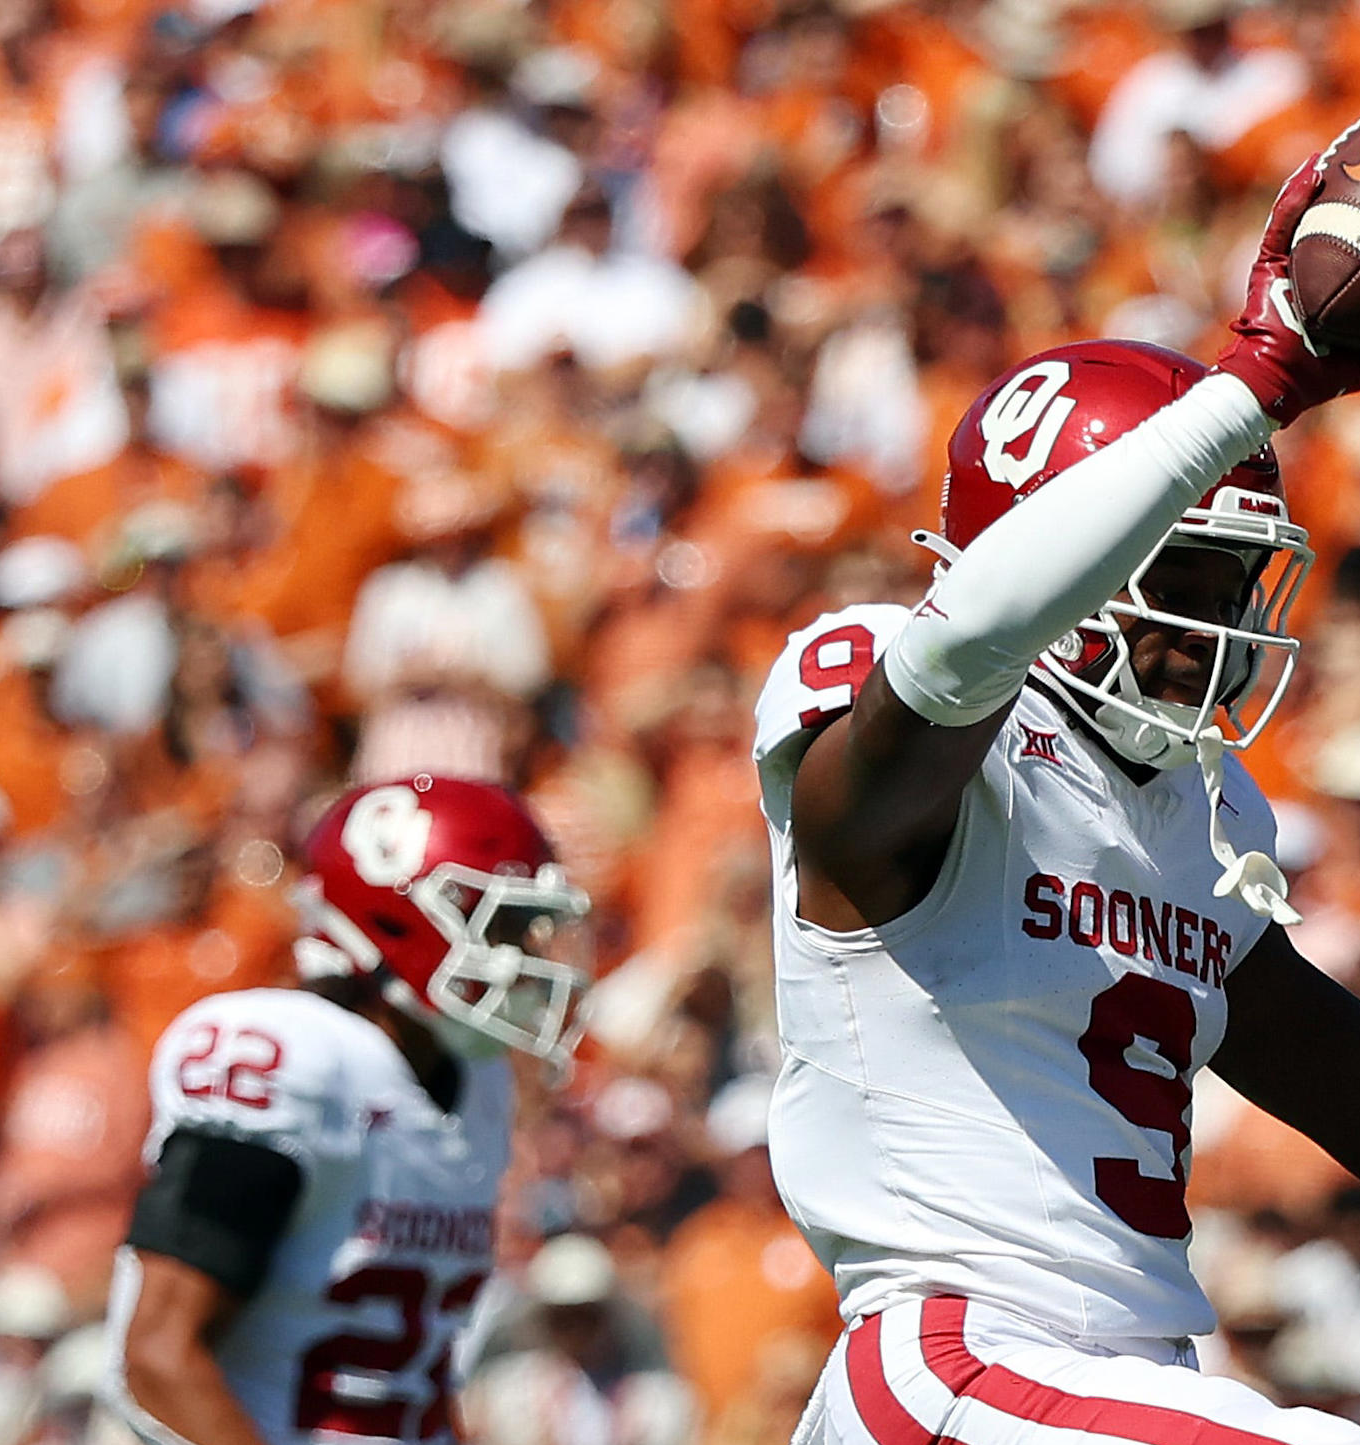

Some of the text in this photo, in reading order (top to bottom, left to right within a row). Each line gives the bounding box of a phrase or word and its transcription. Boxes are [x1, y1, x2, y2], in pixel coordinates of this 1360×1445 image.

[980, 360, 1077, 490] OU
[799, 624, 875, 729] 9
[1022, 872, 1231, 989] SOONERS
[179, 1024, 284, 1108] 22
[1079, 972, 1199, 1240] 9
